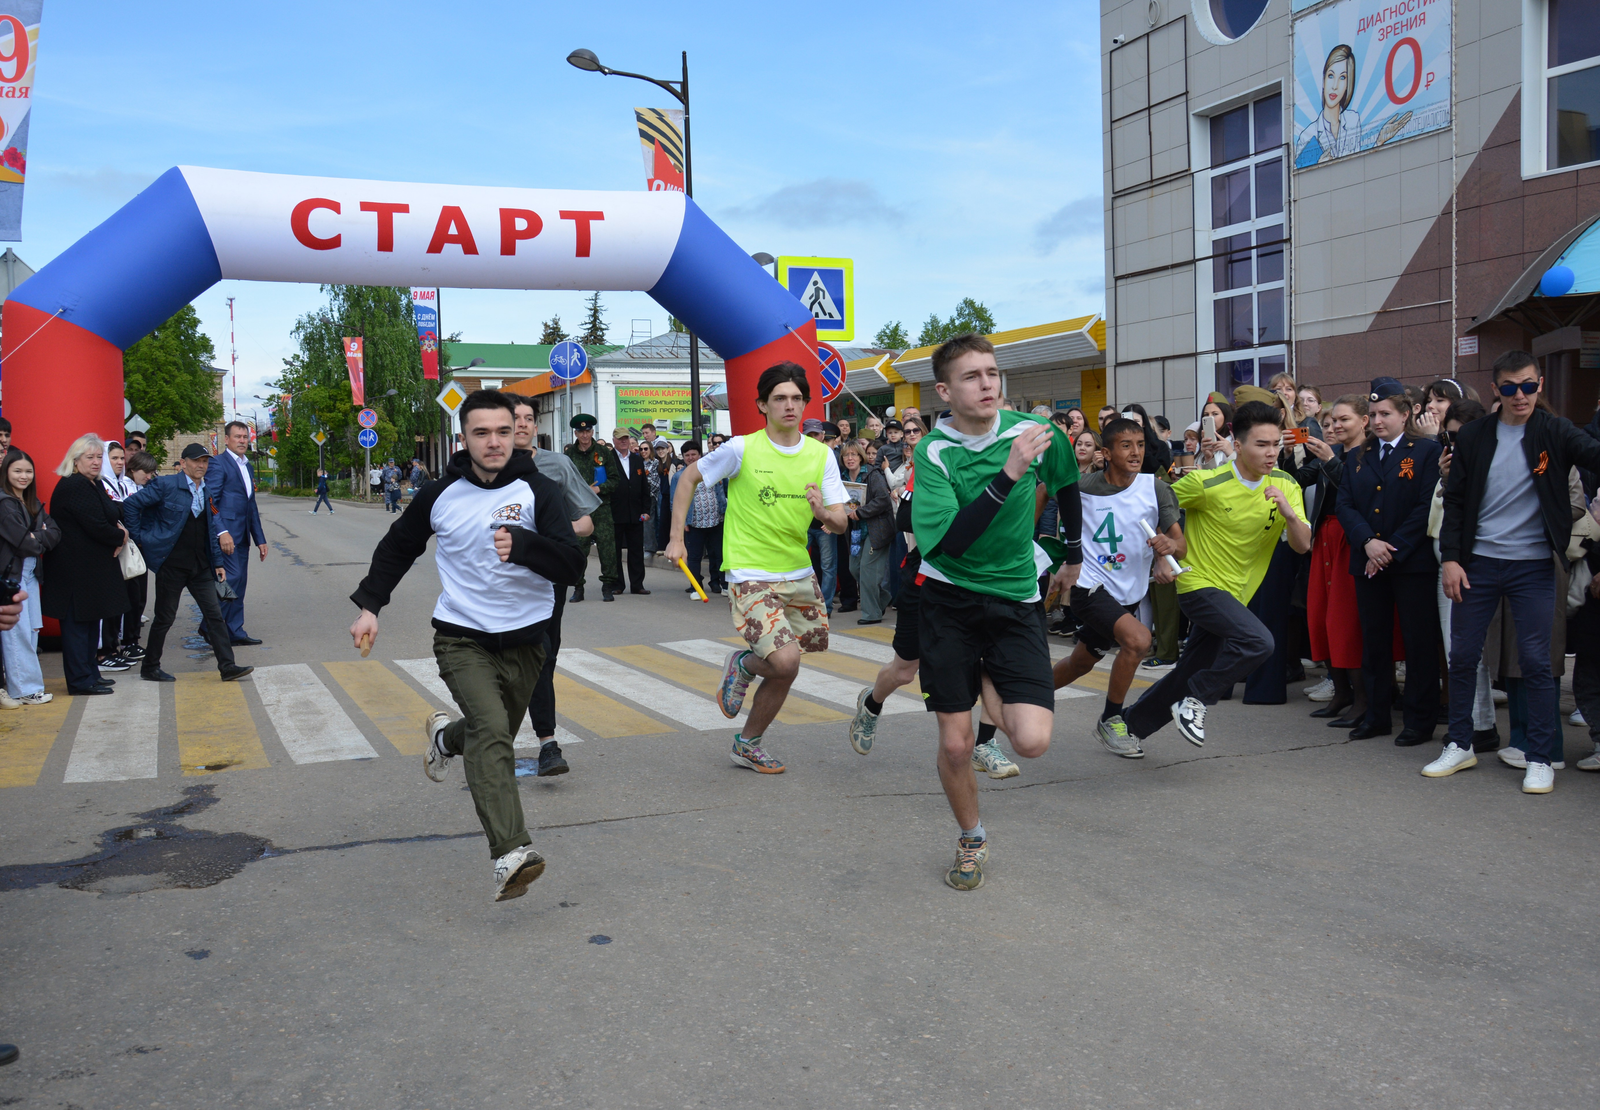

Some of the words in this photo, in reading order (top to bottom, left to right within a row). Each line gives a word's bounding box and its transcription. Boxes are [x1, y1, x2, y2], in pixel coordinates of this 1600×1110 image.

[1357, 0, 1440, 35] ДИАГНОСТИ
[1377, 11, 1426, 42] ЗРЕНИЯ
[0, 14, 30, 83] 9
[1384, 36, 1423, 105] 0
[290, 197, 605, 258] СТАРТ
[412, 290, 418, 300] 9
[419, 290, 435, 300] МАЯ
[350, 342, 359, 351] 9
[618, 389, 660, 397] ЗАПРАВКА
[661, 389, 692, 397] КАРТРИ
[1092, 511, 1123, 554] 4
[1264, 506, 1278, 531] 5
